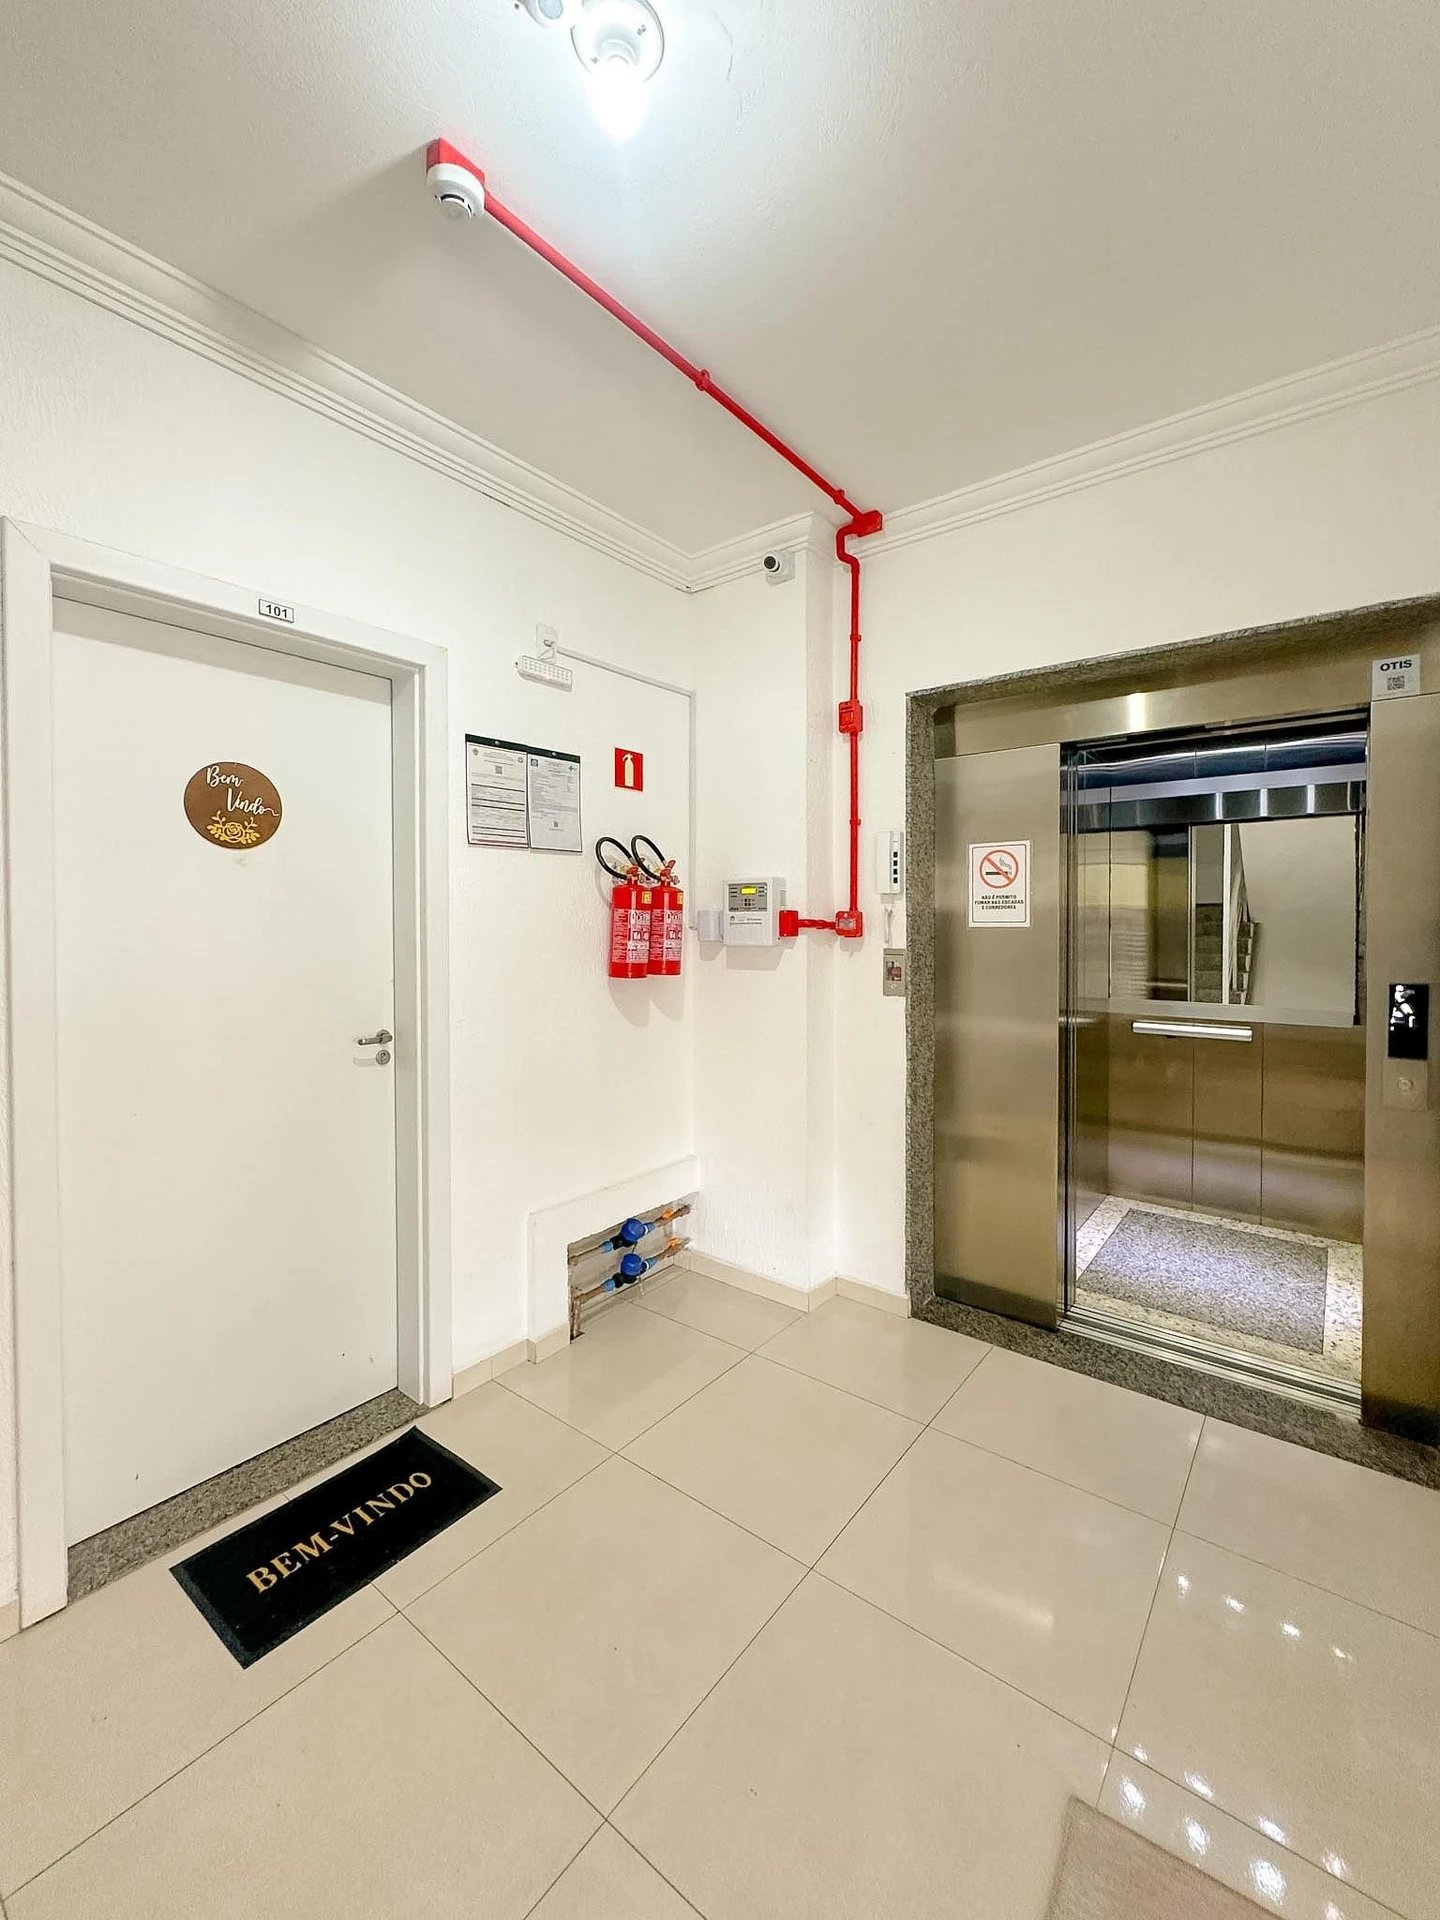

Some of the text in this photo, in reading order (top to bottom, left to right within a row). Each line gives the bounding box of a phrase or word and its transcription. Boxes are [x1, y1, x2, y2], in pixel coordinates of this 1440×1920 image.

[266, 604, 287, 618] 101
[1380, 659, 1412, 671] OTIS
[206, 765, 244, 787] Bem
[227, 787, 279, 817] Vindo
[245, 1471, 432, 1593] BEM-VINDO
